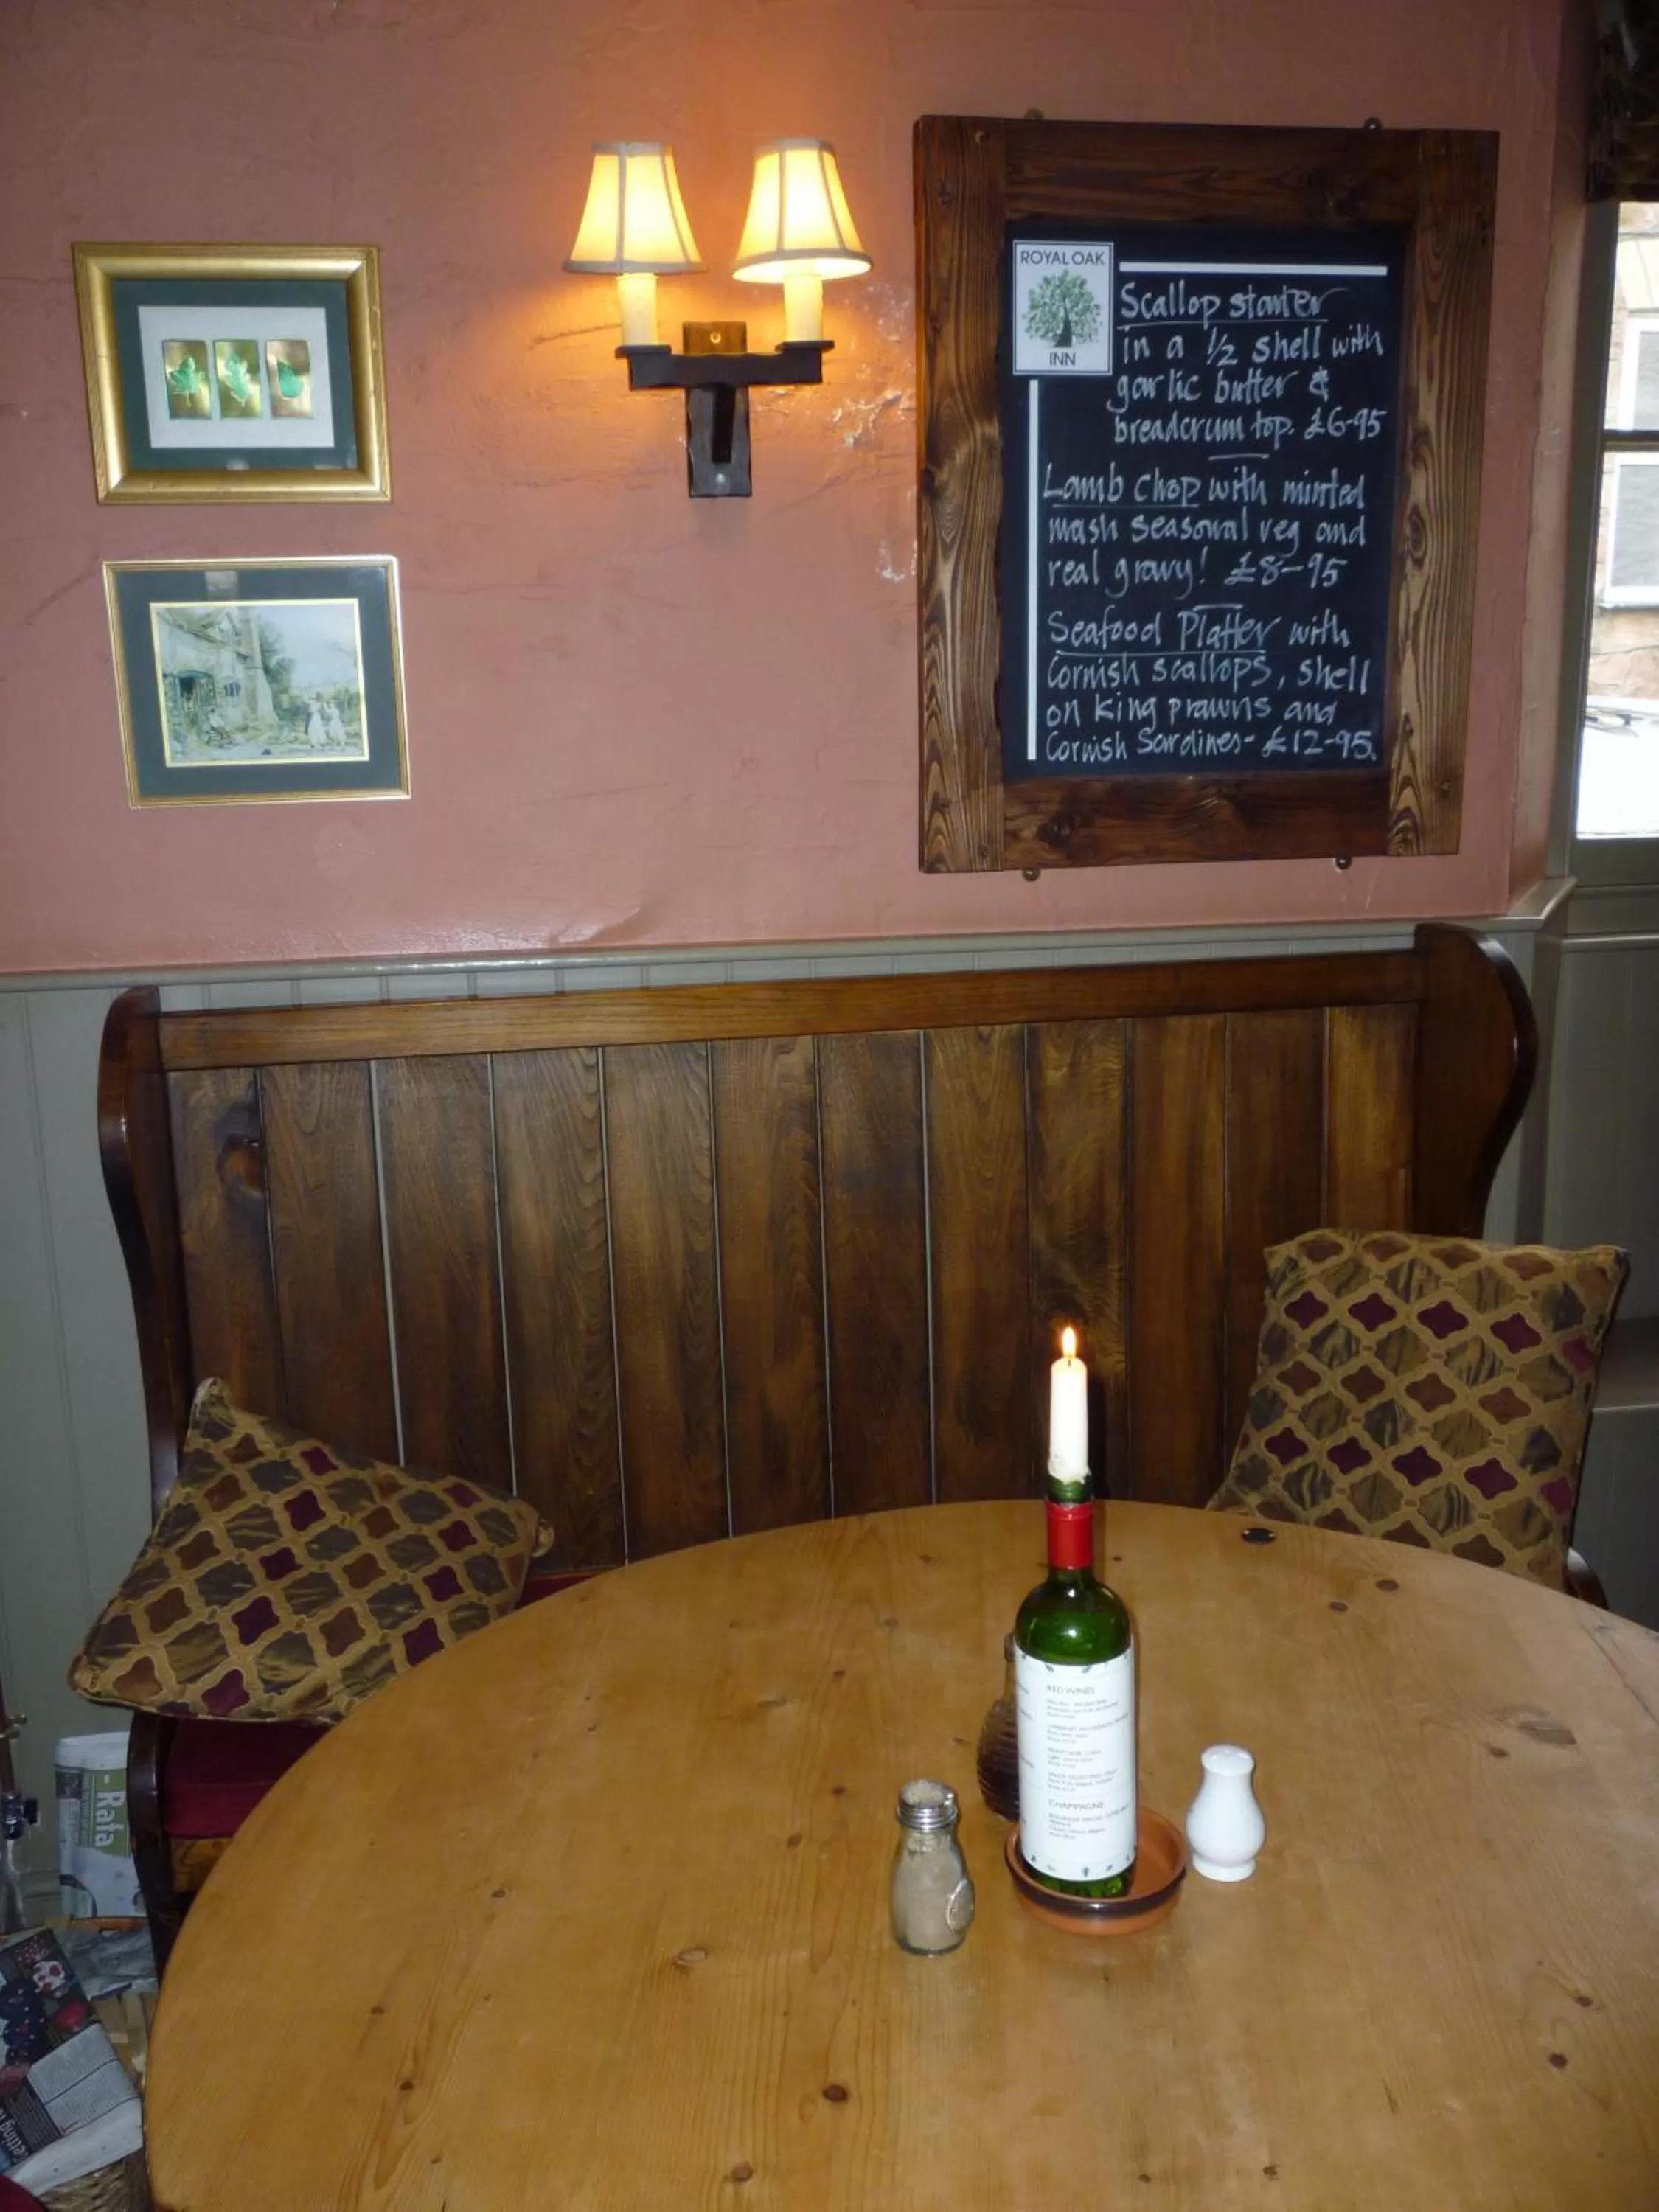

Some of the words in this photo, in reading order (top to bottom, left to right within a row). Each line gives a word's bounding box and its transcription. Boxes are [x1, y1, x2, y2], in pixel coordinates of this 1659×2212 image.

[1020, 249, 1070, 266] ROYAL
[1071, 251, 1105, 267] OAK
[1121, 280, 1221, 330] Scallop
[1049, 352, 1076, 366] INN
[1123, 325, 1150, 364] in
[1166, 335, 1184, 360] a
[1251, 325, 1321, 364] shell
[1332, 324, 1384, 358] with
[1215, 367, 1298, 405] butter
[1043, 462, 1124, 504] Lamb
[1208, 466, 1267, 505] with
[1282, 467, 1366, 509] minted
[1048, 514, 1119, 544] mash
[1259, 515, 1301, 557] veg
[1315, 515, 1366, 546] and
[1048, 549, 1101, 587] real
[1105, 546, 1208, 599] gravy!
[1048, 605, 1161, 646] Seafood
[1177, 610, 1283, 652] Platter
[1288, 603, 1352, 647] with
[1047, 655, 1141, 689] Cornish
[1046, 699, 1081, 728] on
[1169, 695, 1273, 726] prawns
[1284, 699, 1339, 726] and
[1046, 731, 1128, 762] Cornish
